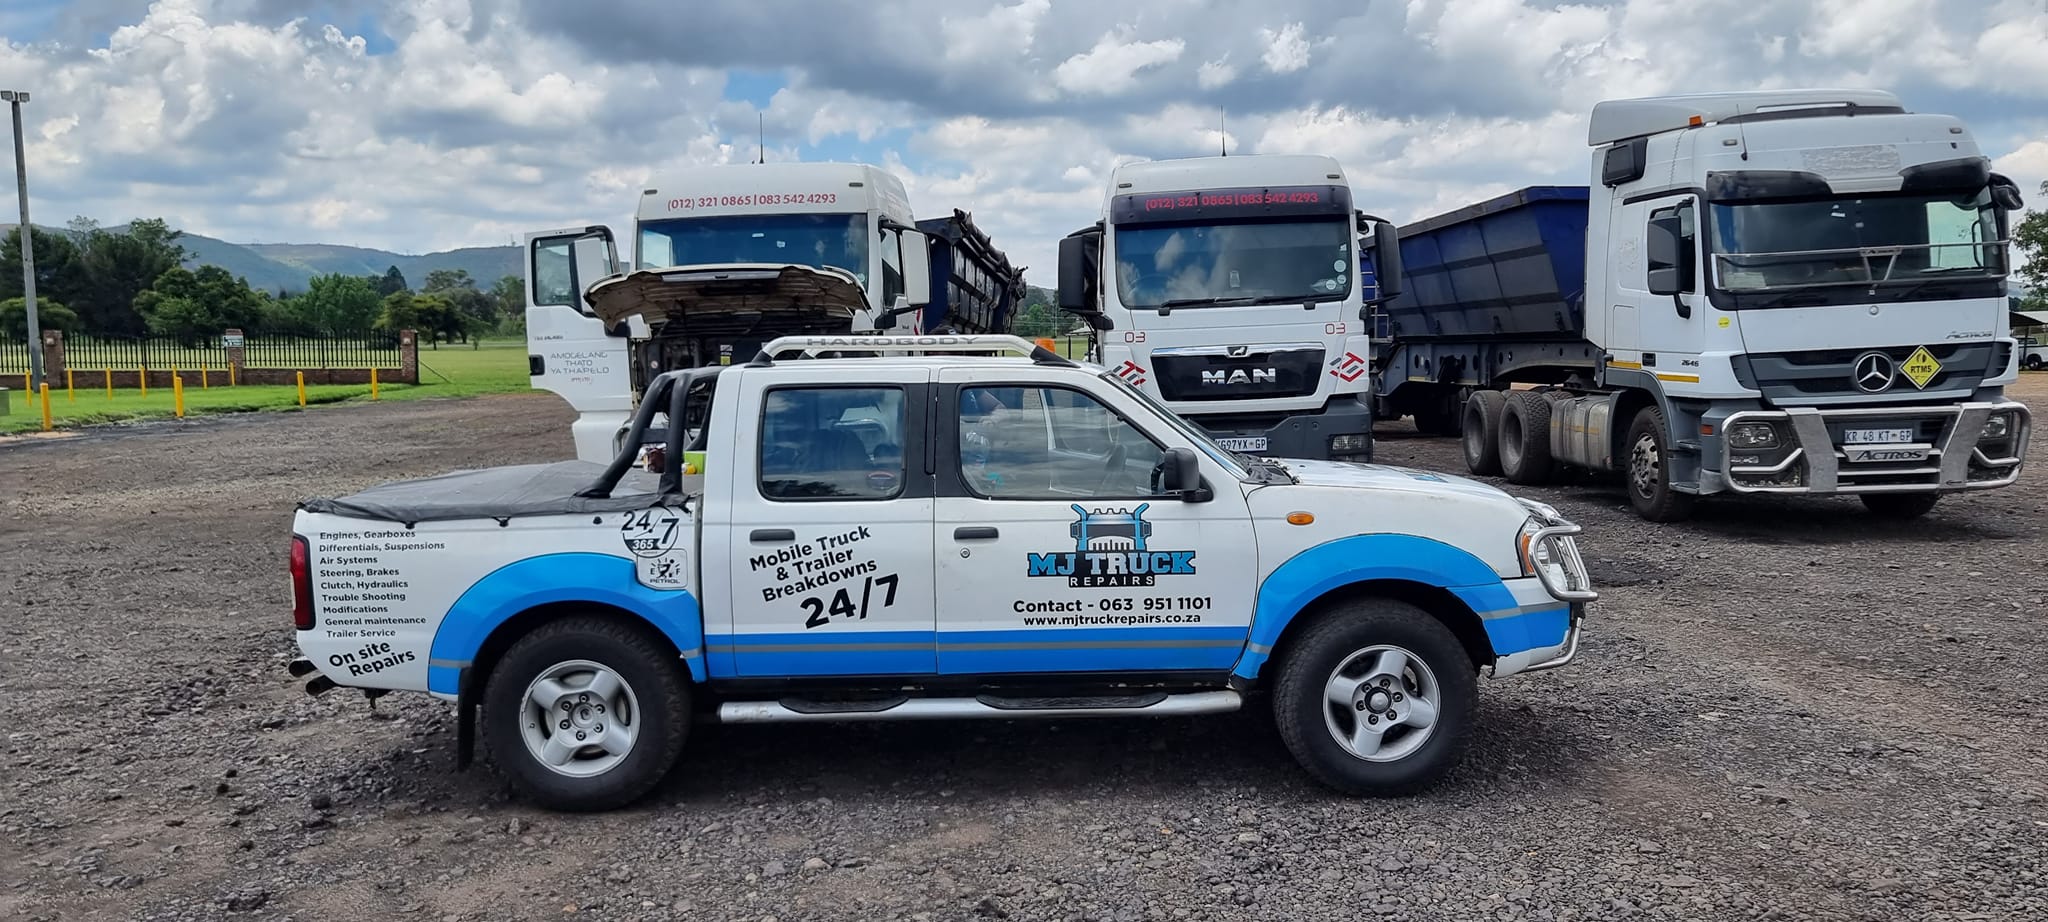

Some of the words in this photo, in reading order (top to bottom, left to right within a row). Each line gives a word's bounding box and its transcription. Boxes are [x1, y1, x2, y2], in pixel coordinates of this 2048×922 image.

[668, 199, 695, 211] (012)
[698, 197, 718, 207] 321
[721, 195, 751, 206] 0865
[759, 194, 781, 205] 083
[783, 194, 805, 204] 542
[807, 193, 836, 204] 4293
[1145, 199, 1175, 211] (012)
[1177, 196, 1199, 207] 321
[1202, 195, 1233, 206] 0865
[1241, 194, 1263, 205] 083
[1264, 193, 1287, 204] 542
[1288, 192, 1319, 203] 4293
[1325, 323, 1346, 334] 03
[807, 337, 978, 346] HARDBODY
[1124, 331, 1146, 343] 03
[1910, 365, 1932, 373] RTMS
[1201, 368, 1277, 385] MAN
[320, 531, 361, 540] Engines,
[364, 530, 416, 538] Gearboxes
[319, 543, 382, 552] Differentials,
[384, 541, 445, 551] Suspensions
[632, 540, 654, 549] 365
[750, 544, 812, 571] Mobile
[816, 525, 871, 551] Truck
[320, 557, 334, 565] Air
[337, 556, 378, 565] Systems
[776, 567, 789, 581] &
[792, 549, 853, 575] Trailer
[1027, 553, 1076, 576] MJ
[1085, 551, 1195, 575] TRUCK
[320, 569, 364, 577] Steering,
[367, 568, 400, 576] Brakes
[321, 582, 355, 590] Clutch,
[357, 581, 408, 590] Hydraulics
[762, 559, 877, 602] Breakdowns
[1070, 576, 1154, 586] REPAIRS
[362, 592, 406, 601] Shooting
[800, 573, 899, 629] 24/7
[323, 605, 388, 614] Modifications
[1013, 599, 1082, 613] Contact
[1099, 598, 1133, 611] 063
[1143, 597, 1172, 610] 951
[1177, 597, 1211, 610] 1101
[325, 618, 362, 626] General
[365, 616, 427, 625] maintenance
[1024, 612, 1201, 627] www.mjtruckrepairs.co.za
[326, 630, 358, 638] Trailer
[360, 629, 396, 637] Service
[329, 652, 355, 667] On
[358, 642, 391, 660] site
[348, 650, 416, 677] Repairs
